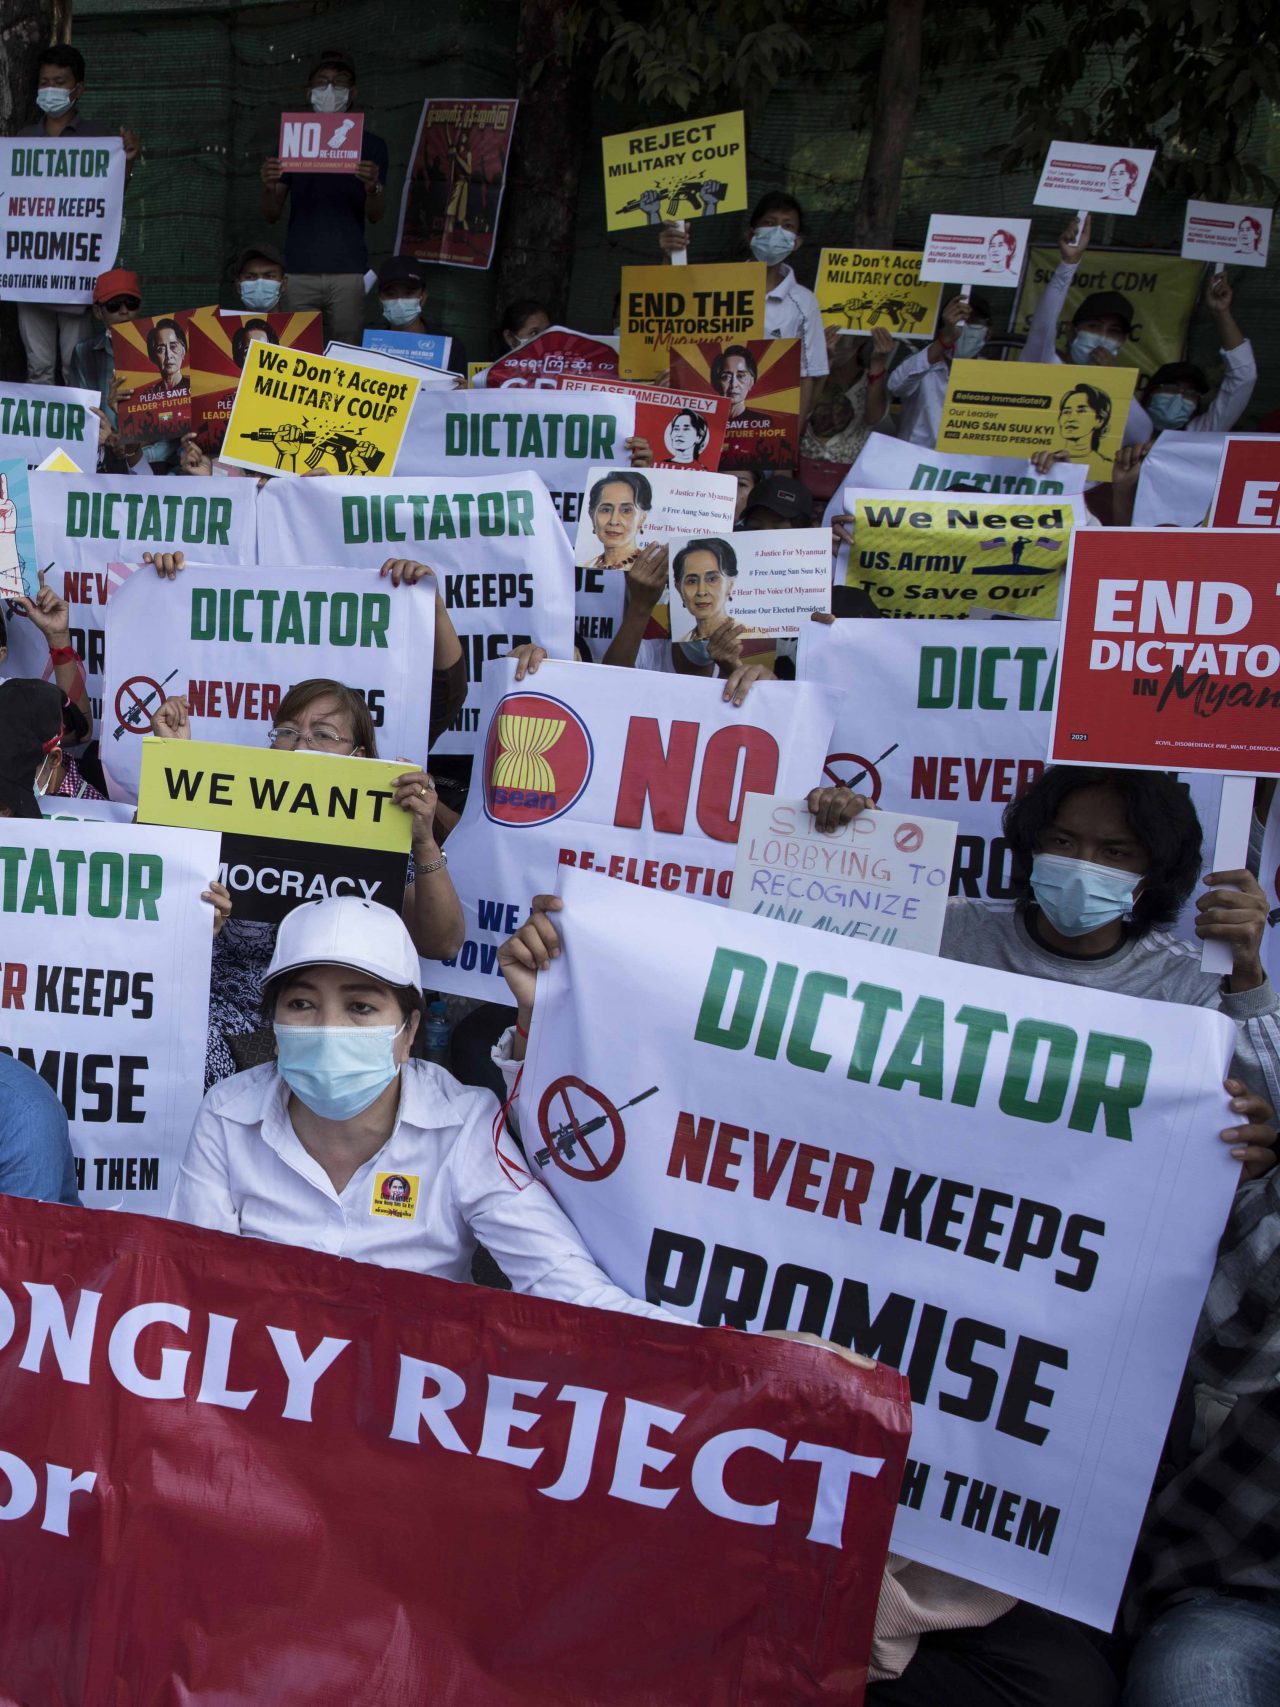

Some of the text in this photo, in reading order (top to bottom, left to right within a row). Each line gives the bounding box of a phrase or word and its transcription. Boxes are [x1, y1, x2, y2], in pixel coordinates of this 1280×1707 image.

[282, 122, 321, 159] NO
[320, 149, 358, 159] RE-ELECTION
[629, 124, 716, 155] REJECT
[11, 148, 110, 178] DICTATOR
[608, 143, 740, 178] MILITARY COUP
[8, 196, 105, 219] NEVER KEEPS
[6, 231, 102, 262] PROMISE
[51, 275, 76, 290] WITH
[628, 290, 754, 317] END THE
[628, 318, 754, 334] DICTATORSHIP
[258, 350, 408, 401] We Don't Accept
[254, 375, 398, 424] MILITARY COUP
[445, 412, 617, 460] DICTATOR
[946, 420, 1055, 436] AUNG SAN SUU KYI
[65, 491, 232, 546] DICTATOR
[342, 490, 535, 545] DICTATOR
[864, 506, 1064, 529] We Need
[782, 549, 827, 558] For Myanmar
[859, 551, 967, 574] US.Army
[769, 567, 827, 577] Aung San Suu Kyi
[445, 573, 534, 609] KEEPS
[859, 580, 1045, 601] To Save Our
[1094, 579, 1253, 635] END
[190, 587, 392, 648] DICTATOR
[758, 604, 826, 615] Our Elected President
[188, 679, 280, 721] NEVER
[1133, 678, 1158, 696] IN
[164, 767, 393, 823] WE WANT
[748, 839, 946, 887] LOBBYING TO
[751, 869, 920, 919] RECOGNIZE
[35, 966, 154, 1020] KEEPS
[694, 945, 1153, 1142] DICTATOR
[92, 1157, 159, 1191] THEM
[666, 1110, 1106, 1293] NEVER KEEPS
[389, 1352, 886, 1550] REJECT
[943, 1470, 1061, 1556] THEM
